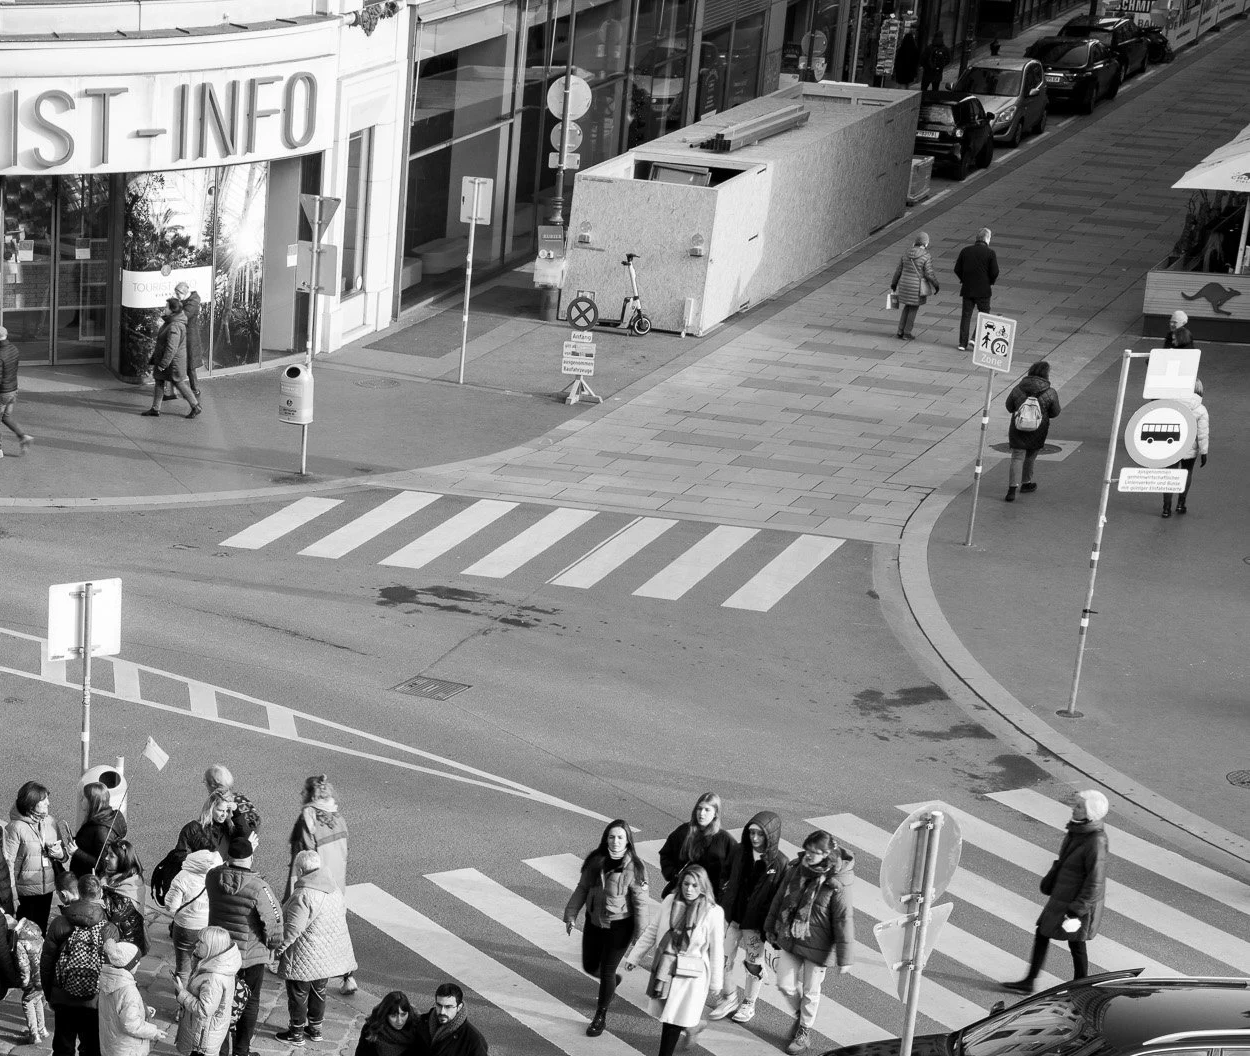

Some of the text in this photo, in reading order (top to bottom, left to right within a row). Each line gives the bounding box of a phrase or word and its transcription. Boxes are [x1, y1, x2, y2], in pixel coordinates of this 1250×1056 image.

[572, 333, 592, 341] Anfang
[996, 343, 1006, 354] 20
[981, 353, 1003, 367] Zone
